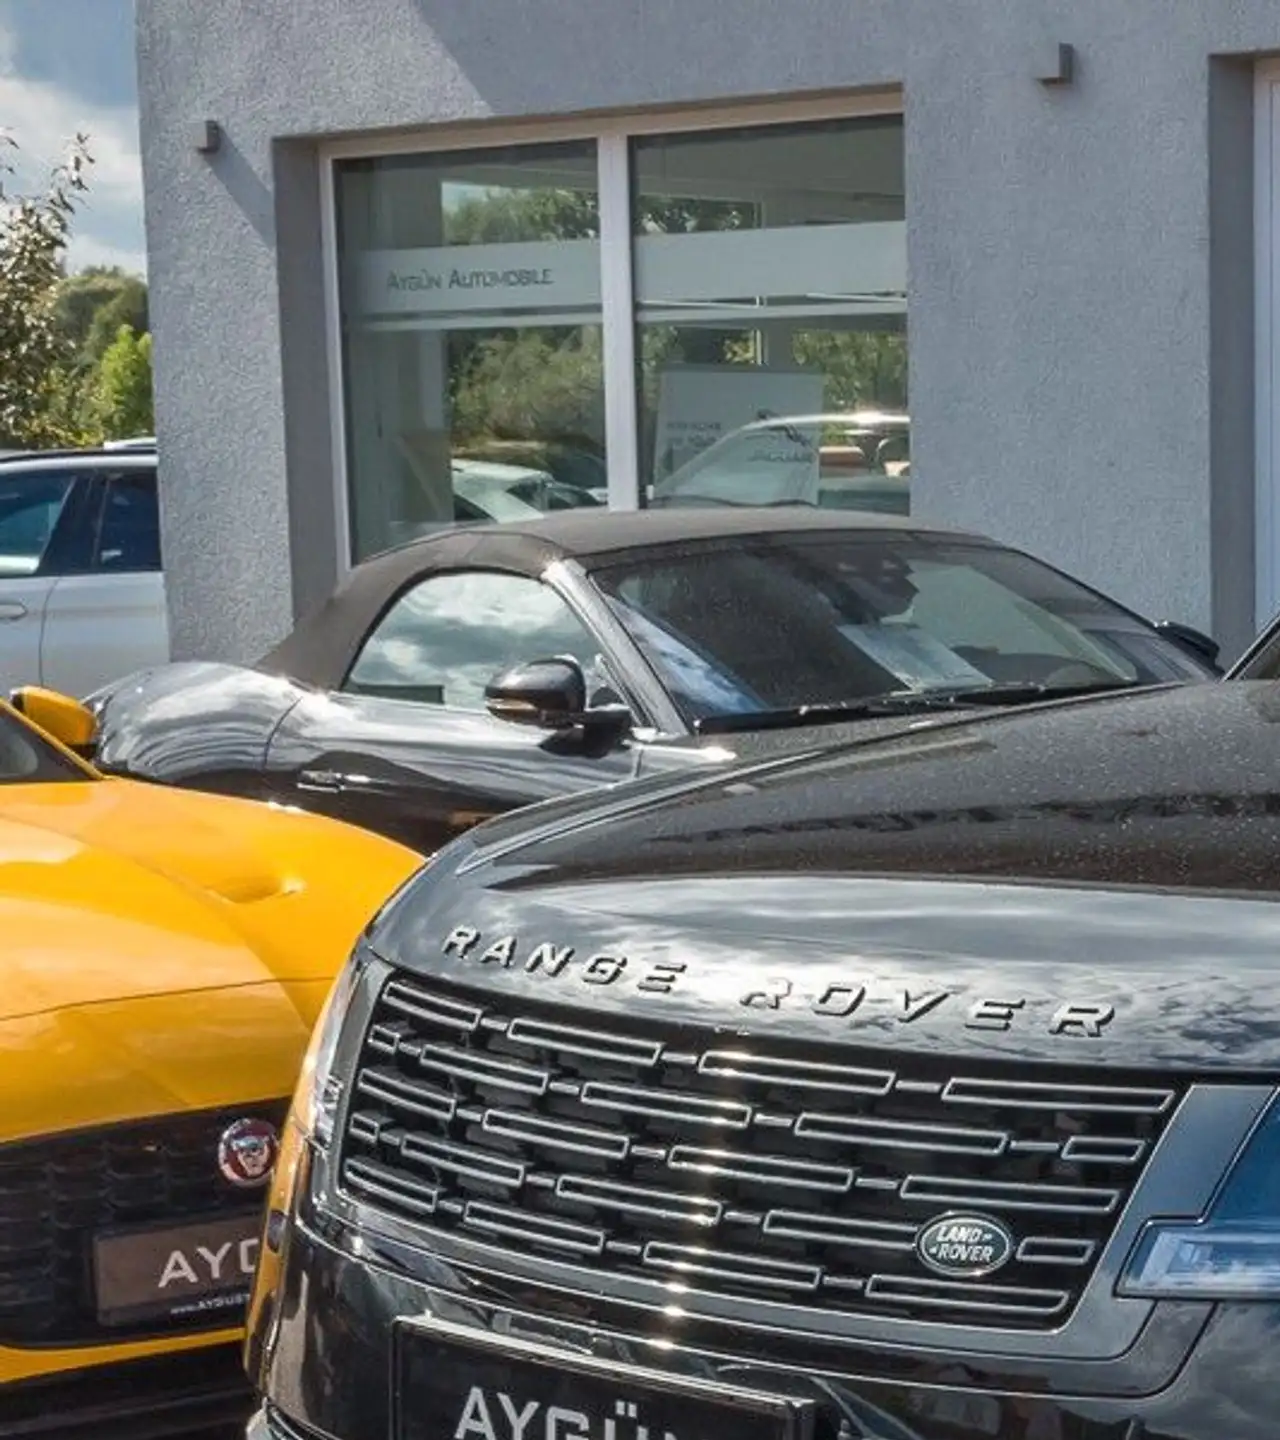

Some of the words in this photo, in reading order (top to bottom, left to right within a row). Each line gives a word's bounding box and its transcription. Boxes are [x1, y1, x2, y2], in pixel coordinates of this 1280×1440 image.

[441, 923, 688, 993] RANGE
[738, 976, 1115, 1039] ROVER
[935, 1225, 984, 1243] LAND
[936, 1242, 994, 1263] ROVER
